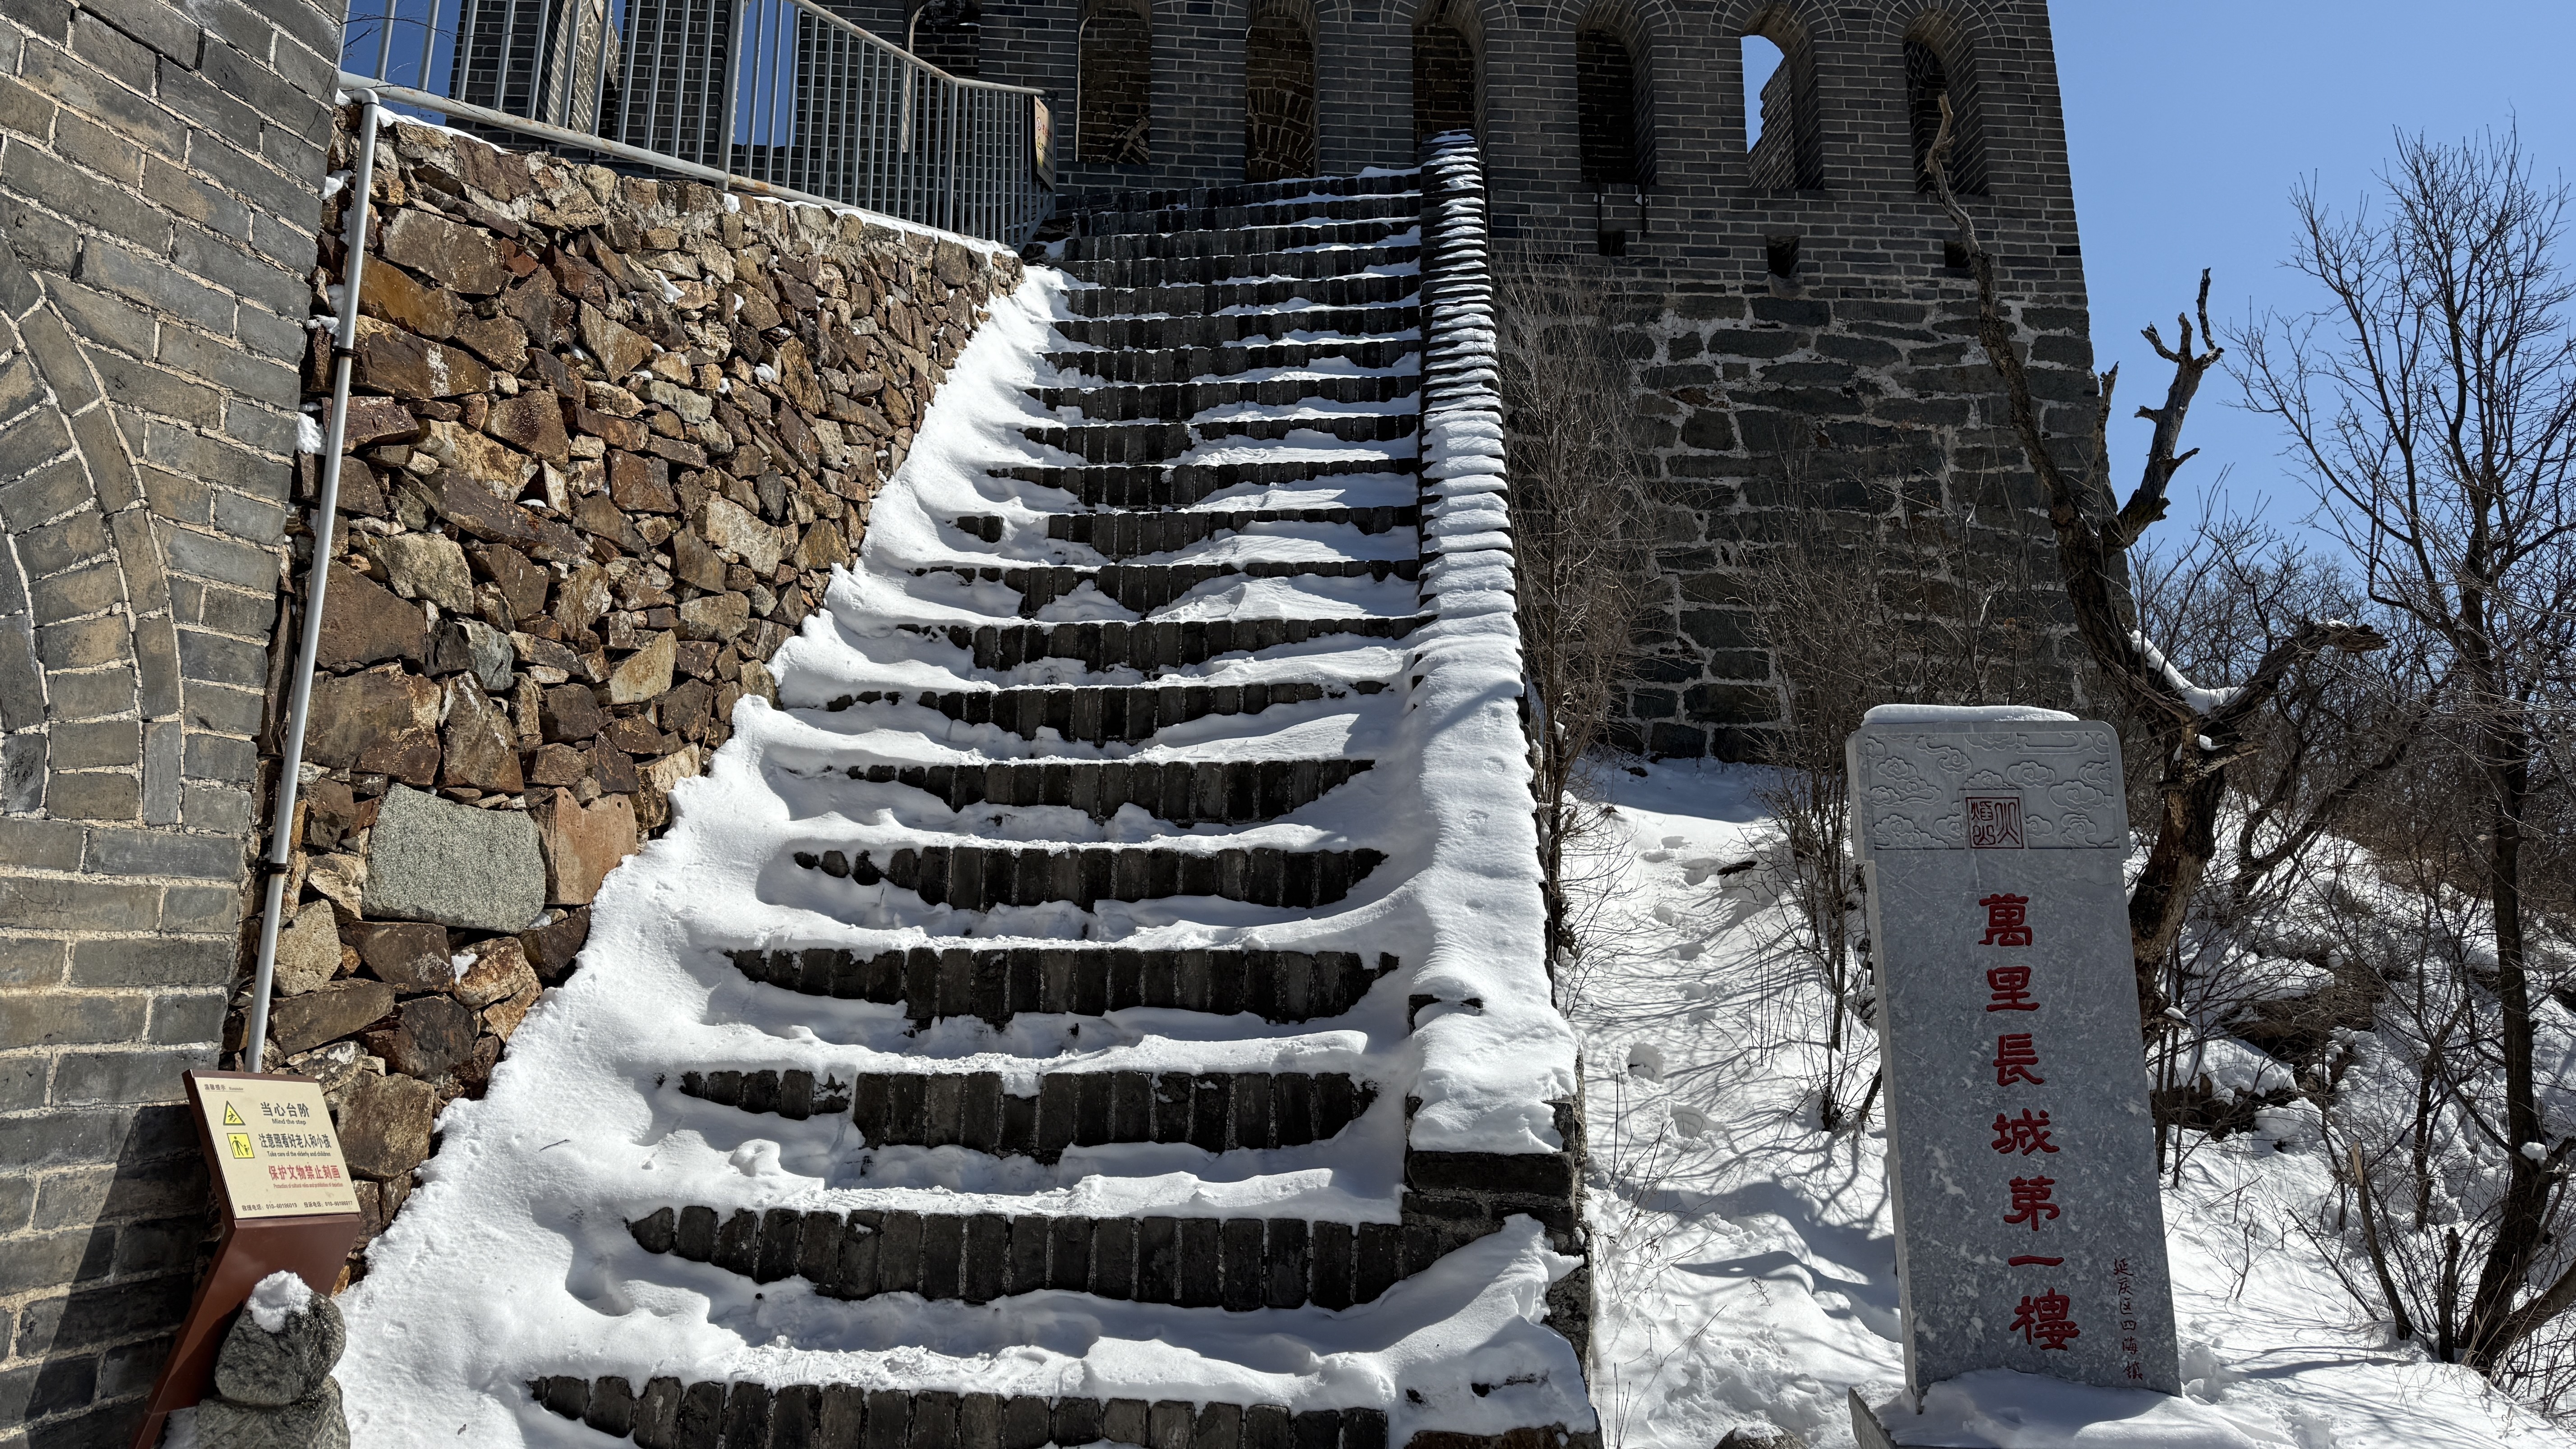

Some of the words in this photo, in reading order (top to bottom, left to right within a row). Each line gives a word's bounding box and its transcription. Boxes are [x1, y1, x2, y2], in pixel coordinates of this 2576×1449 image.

[260, 1102, 309, 1117] 当心台阶
[258, 1133, 331, 1148] 注意照看好老人和小孩
[268, 1164, 340, 1181] 保护文物禁止刻画
